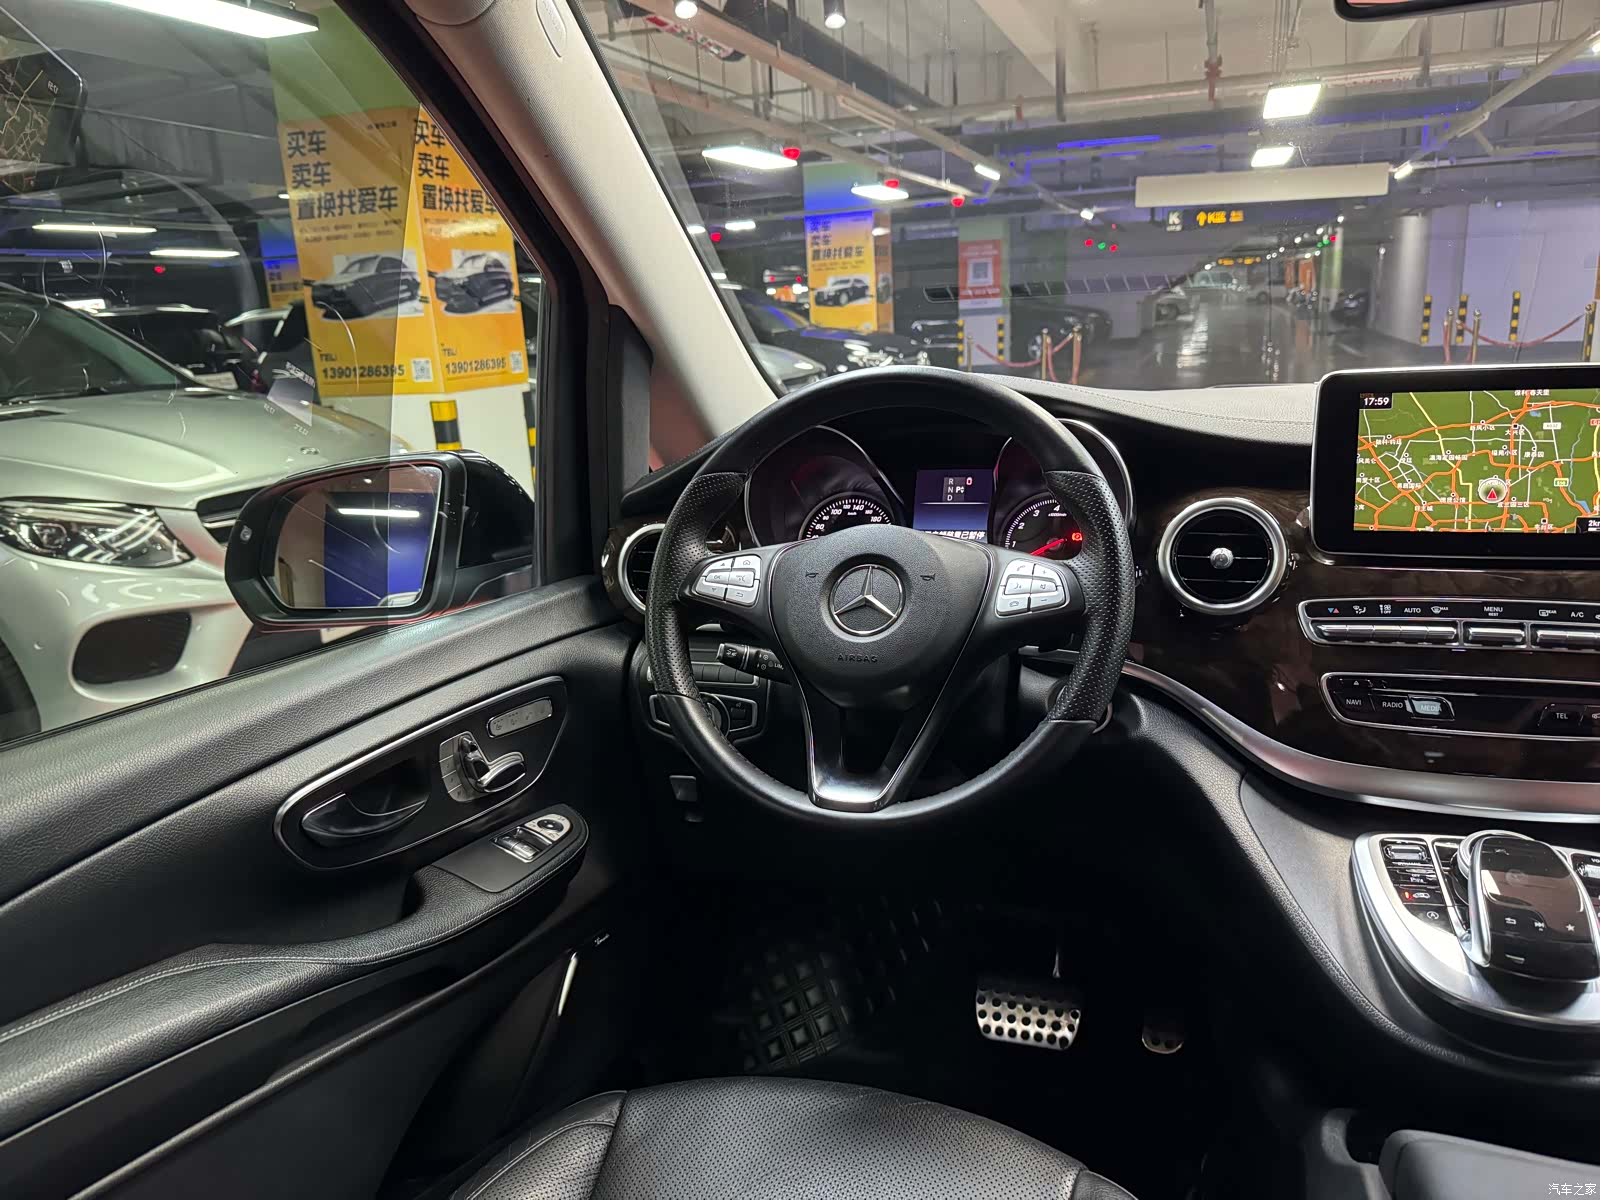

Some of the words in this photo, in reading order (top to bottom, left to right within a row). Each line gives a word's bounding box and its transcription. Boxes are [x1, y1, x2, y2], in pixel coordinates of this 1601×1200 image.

[415, 119, 446, 148] 买车
[288, 130, 326, 158] 买车
[418, 152, 449, 180] 卖车
[292, 161, 331, 189] 卖车
[297, 186, 398, 220] 置换找爱车
[446, 358, 507, 374] 13901286395
[322, 365, 405, 379] 13901286395
[1364, 397, 1390, 406] 17:59
[955, 486, 961, 494] P
[947, 494, 953, 502] D
[1033, 509, 1040, 517] 3
[1018, 522, 1025, 530] 2
[1570, 611, 1585, 619] A/C
[837, 653, 878, 663] AIRBAG
[1346, 698, 1362, 706] NAVI
[1382, 701, 1404, 709] RADIO
[1556, 712, 1569, 720] TEL
